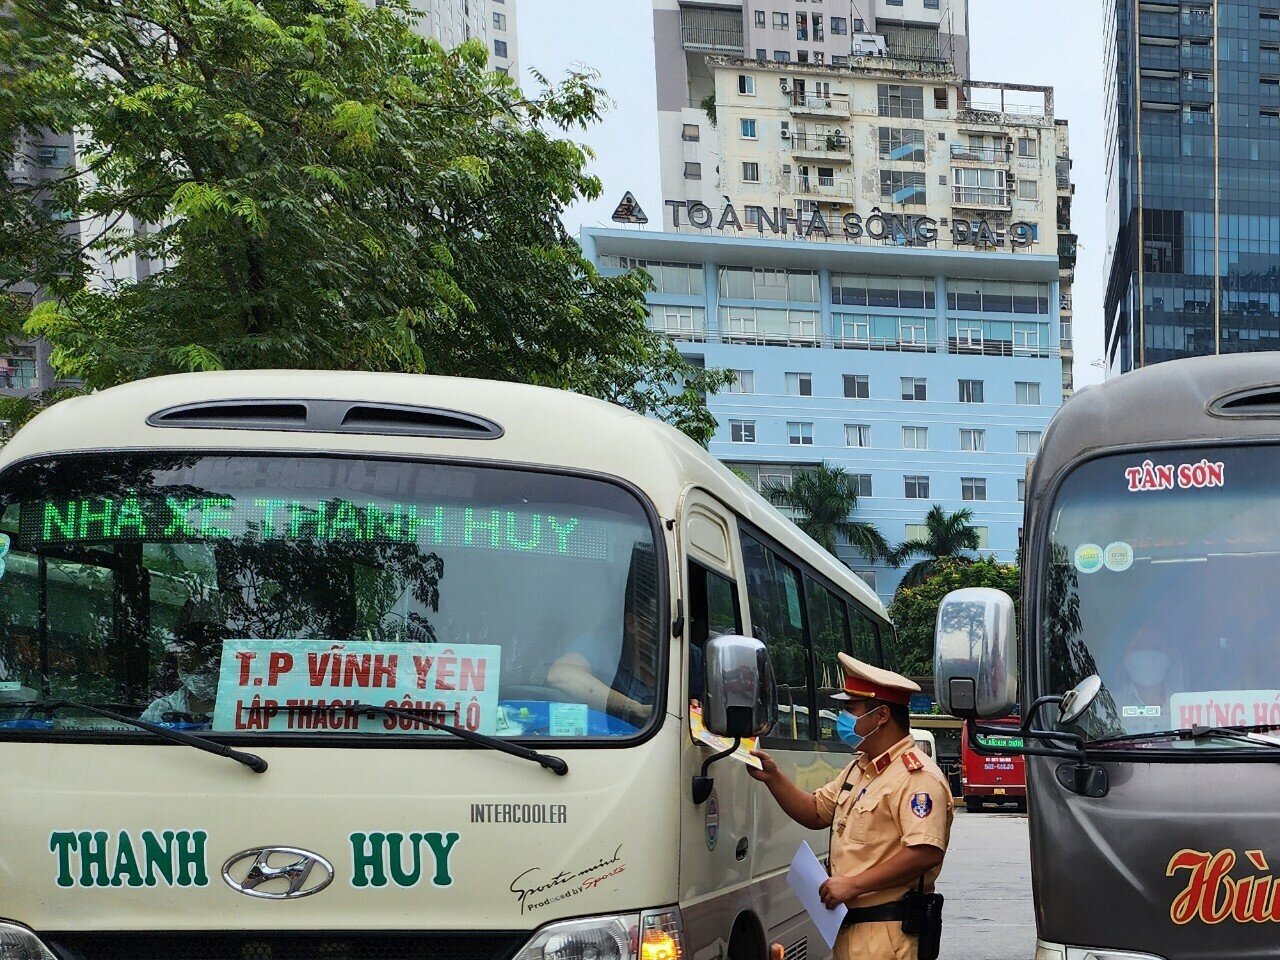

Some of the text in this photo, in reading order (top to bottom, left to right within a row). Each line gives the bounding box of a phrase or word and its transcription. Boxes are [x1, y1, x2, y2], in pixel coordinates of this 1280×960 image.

[757, 203, 832, 238] NHÀ
[843, 206, 938, 242] SÔNG
[1010, 221, 1034, 248] 9
[1125, 458, 1225, 491] TÂN SƠN
[163, 497, 233, 537] XE
[254, 497, 445, 545] THANH
[464, 506, 579, 554] HUY
[236, 644, 487, 691] T.P VĨNH YÊN
[382, 694, 446, 732] SÔNG
[470, 803, 567, 824] INTERCOOLER
[50, 829, 461, 888] THANH HUY
[572, 885, 584, 896] by
